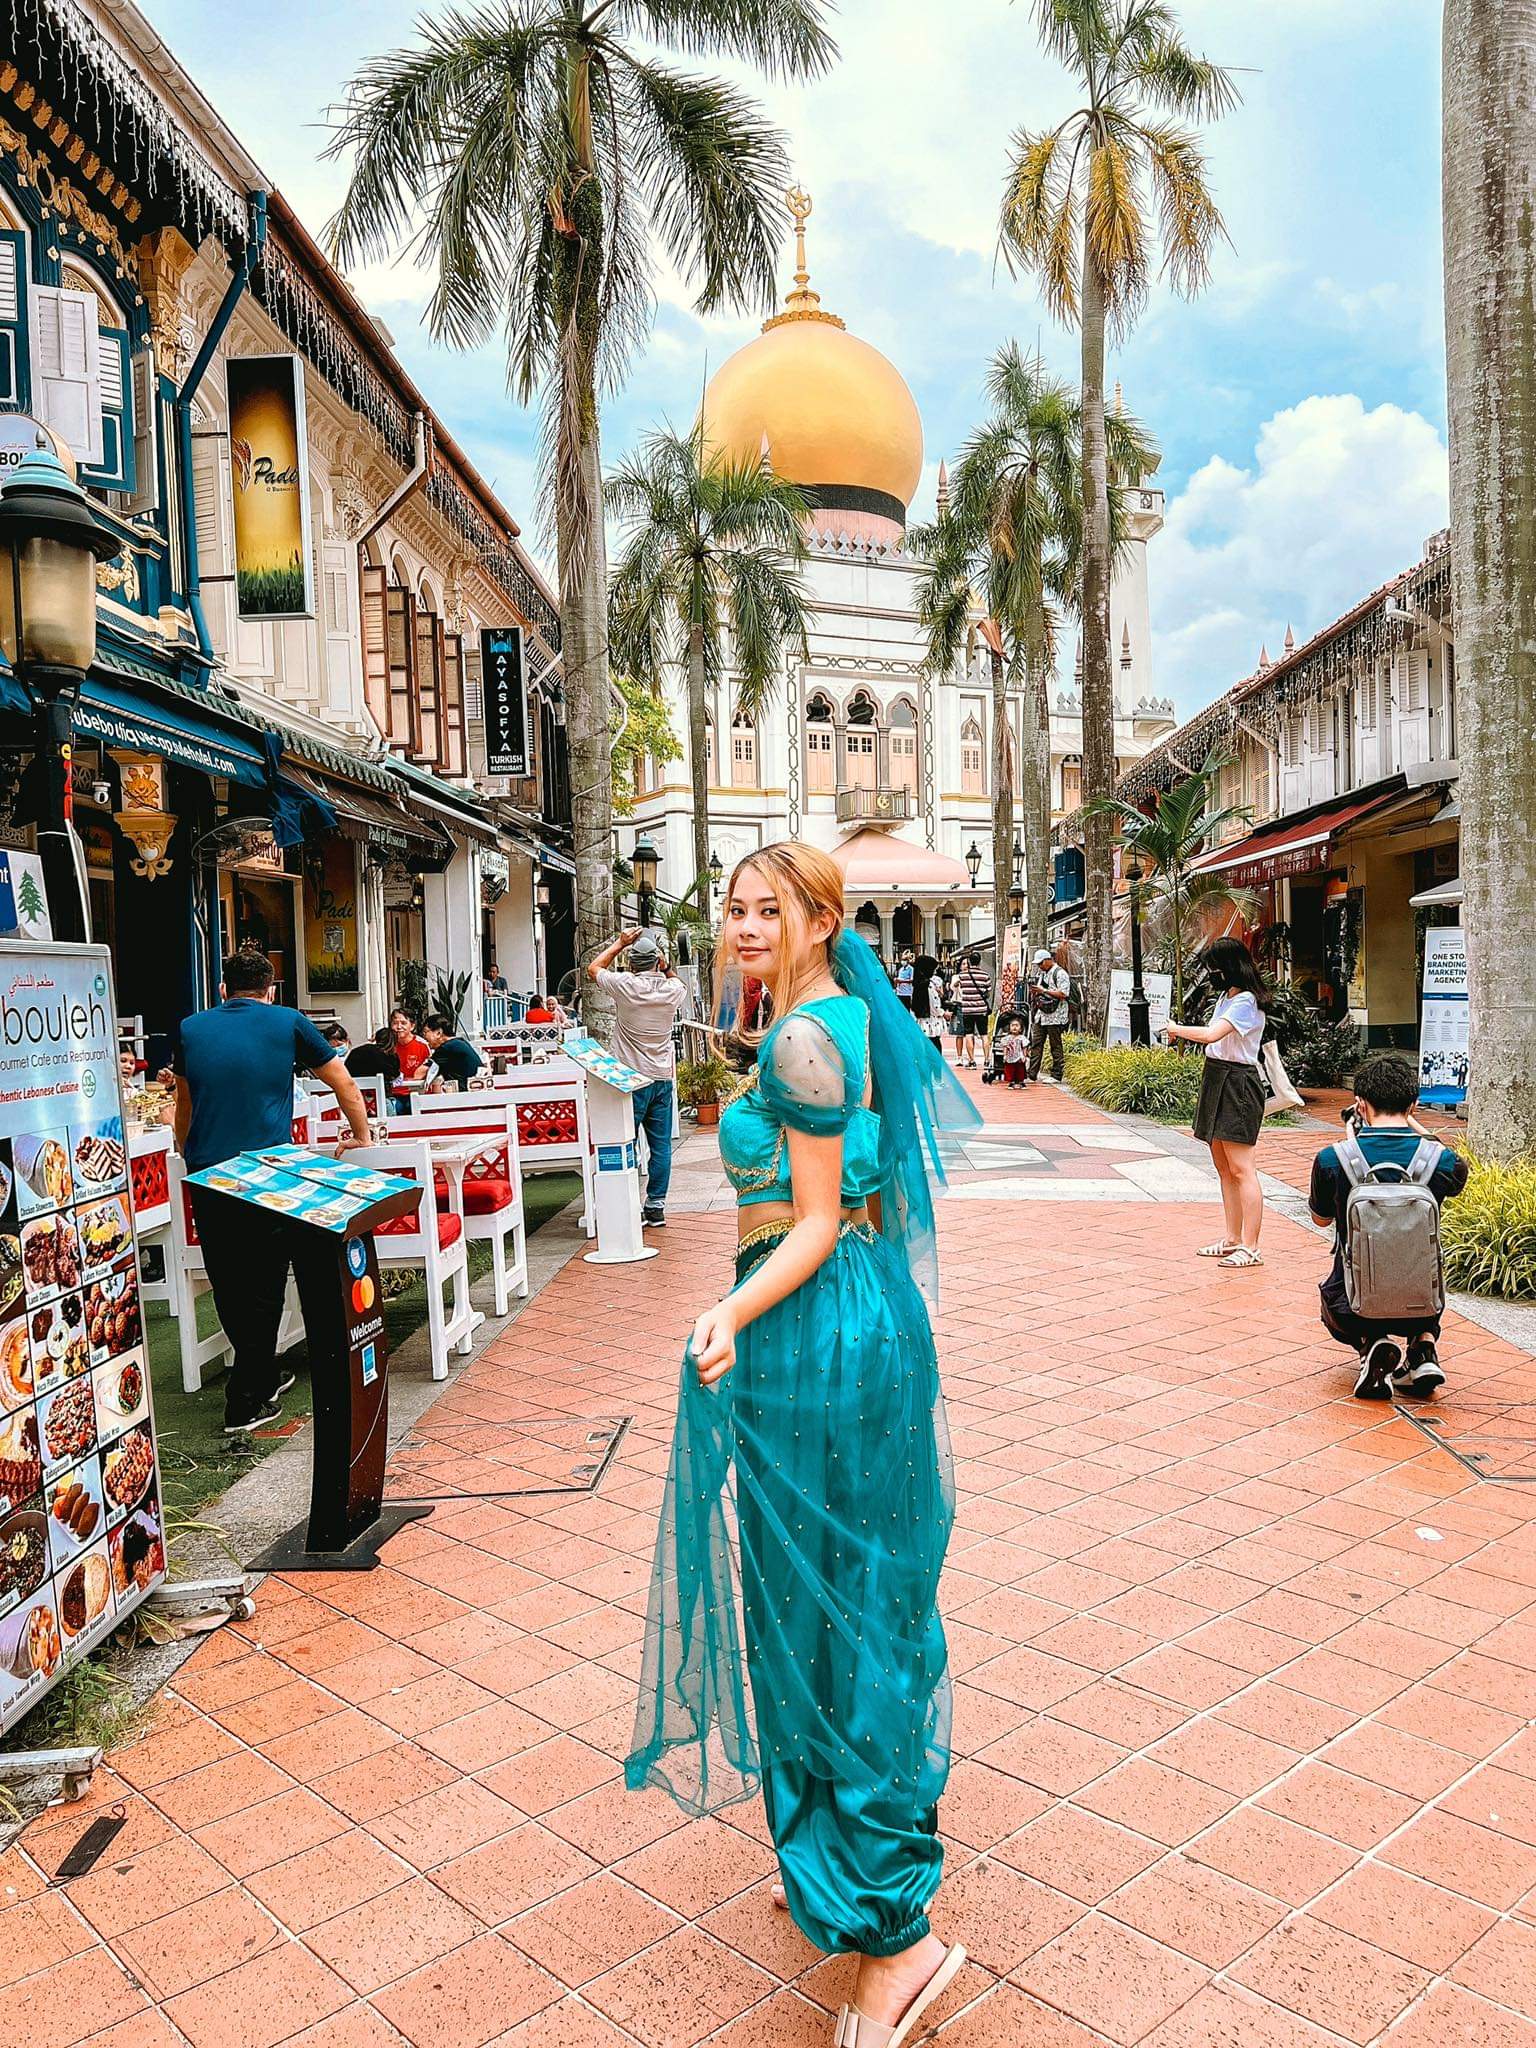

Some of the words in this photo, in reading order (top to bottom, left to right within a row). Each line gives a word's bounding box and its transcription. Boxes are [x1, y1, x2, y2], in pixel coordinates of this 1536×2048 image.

[496, 655, 511, 752] AYASOFYA
[71, 708, 237, 775] ubeboutiquecapsulehotel.com
[490, 755, 522, 765] TURKISH
[490, 764, 523, 772] RESTAURANT
[1432, 953, 1448, 961] ONE
[1449, 953, 1466, 961] STO
[31, 1053, 51, 1068] Cafe
[52, 1052, 68, 1065] and
[69, 1048, 109, 1062] Restaurant
[23, 1083, 55, 1099] Lebanese
[55, 1081, 79, 1095] Cuisine
[350, 1316, 383, 1343] Welcome
